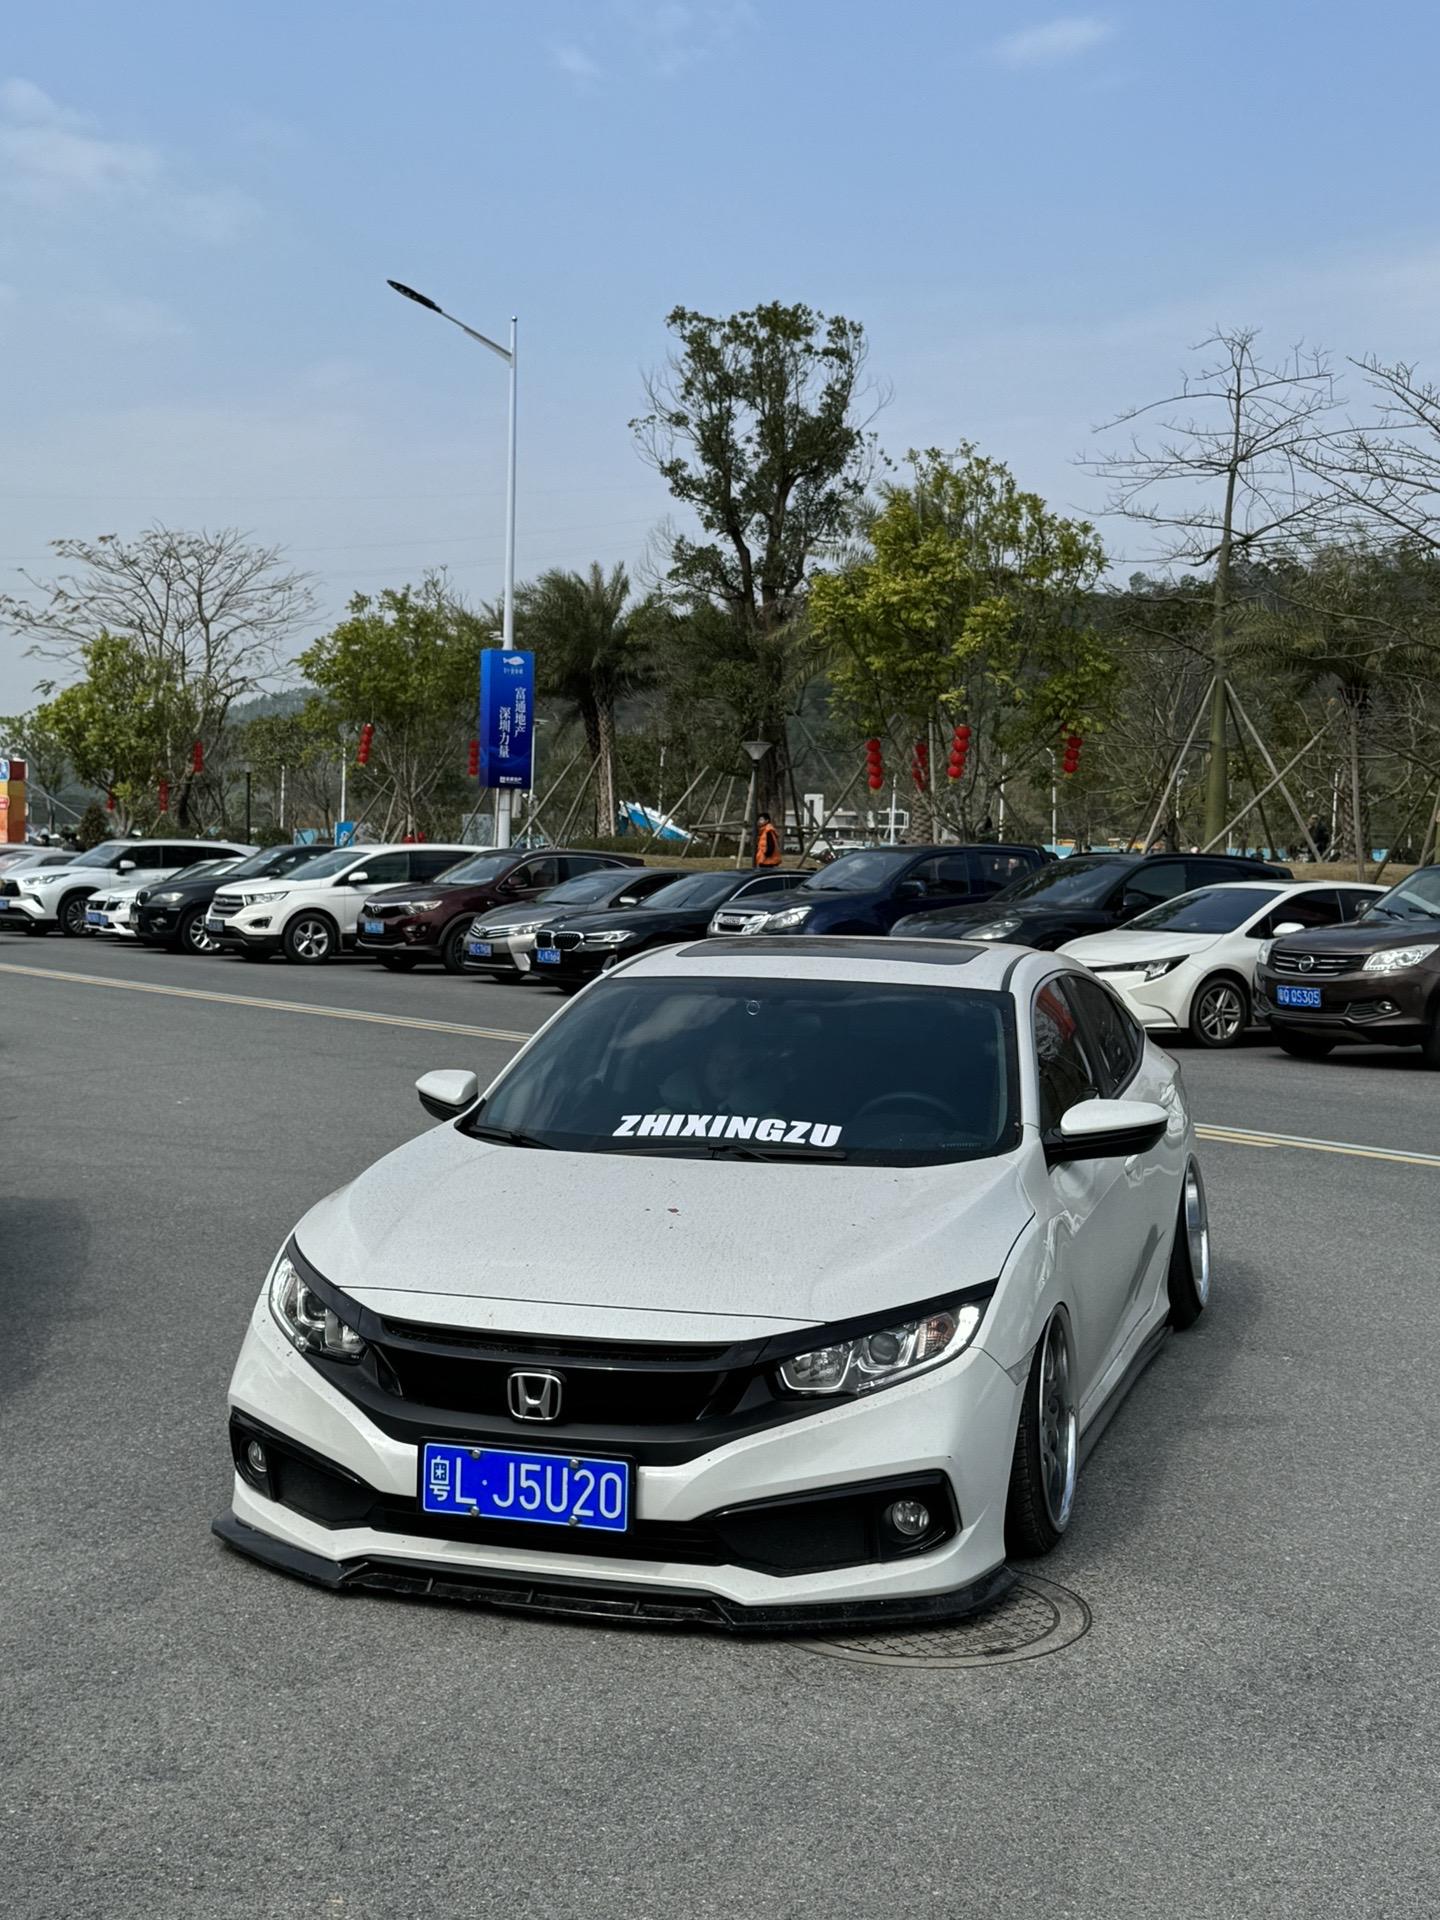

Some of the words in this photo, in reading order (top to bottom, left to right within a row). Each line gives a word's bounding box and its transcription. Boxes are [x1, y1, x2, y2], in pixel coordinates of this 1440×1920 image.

[498, 706, 511, 758] 深圳力量
[514, 686, 527, 737] 富通地产
[612, 1114, 843, 1147] ZHIXINGZU
